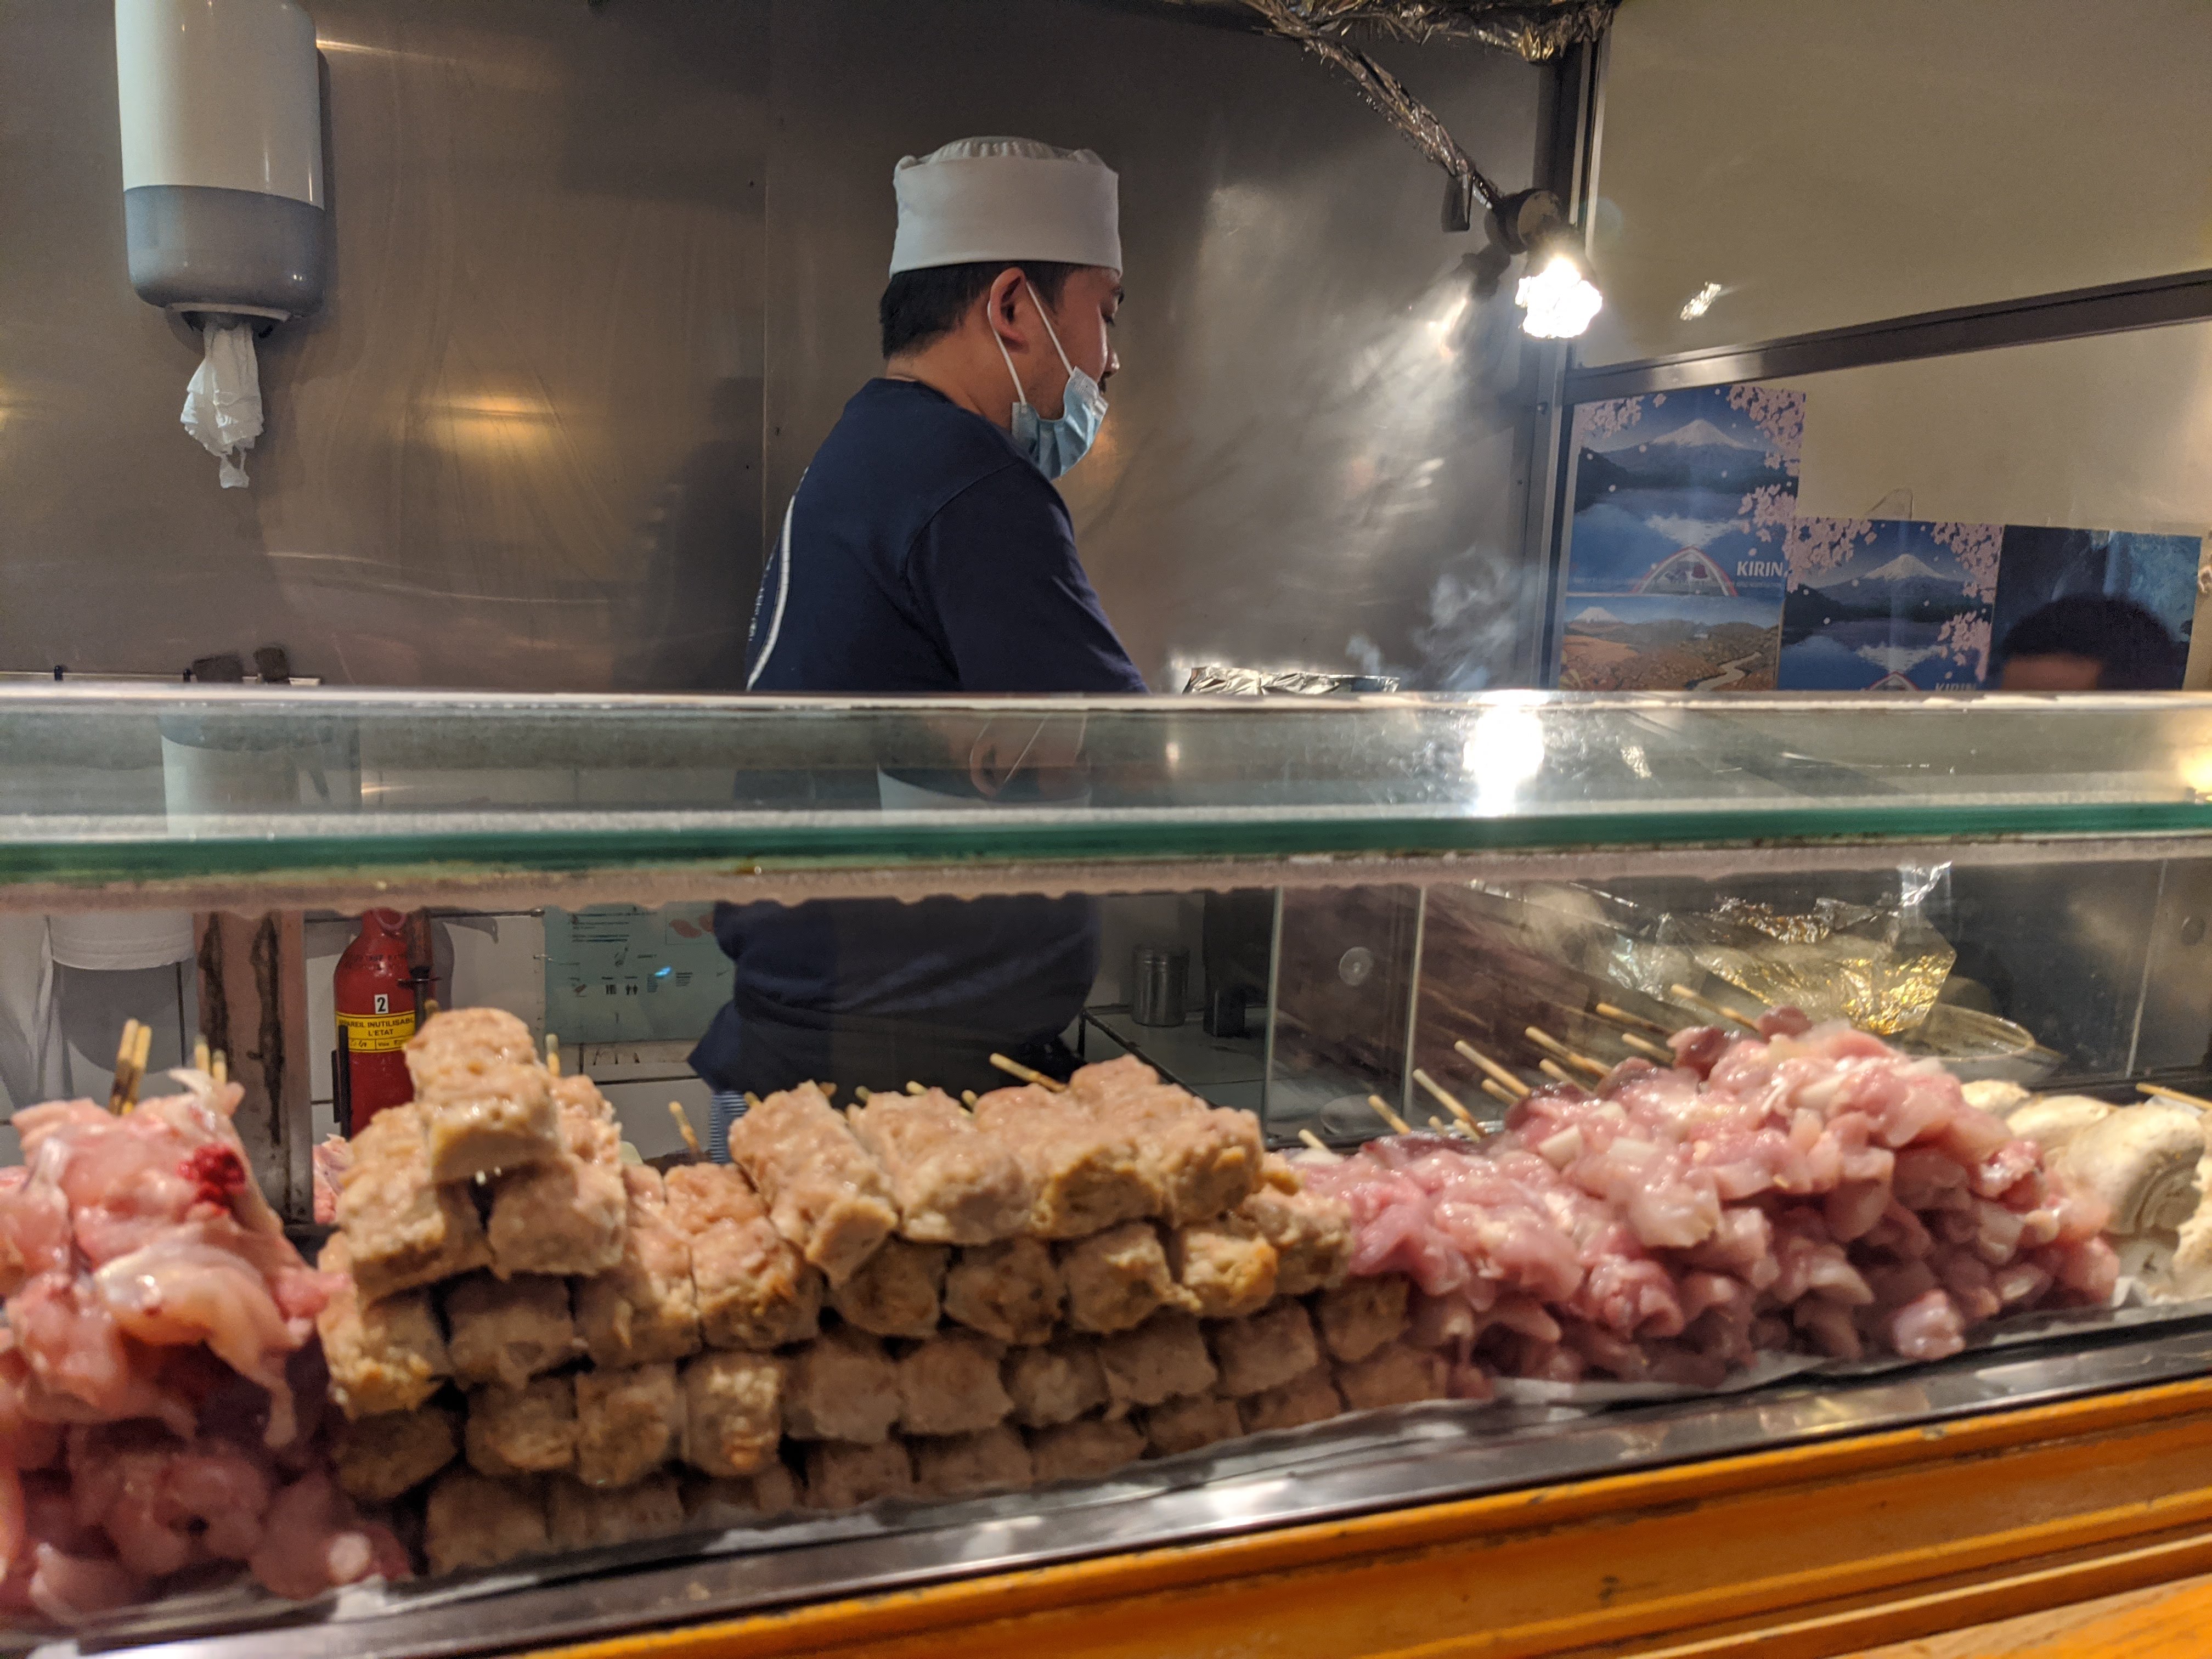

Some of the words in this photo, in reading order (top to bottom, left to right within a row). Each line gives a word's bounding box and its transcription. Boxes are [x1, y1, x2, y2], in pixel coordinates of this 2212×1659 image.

[1736, 560, 1784, 577] KIRIN
[377, 997, 386, 1013] 2
[367, 1018, 414, 1028] INUTILISABL
